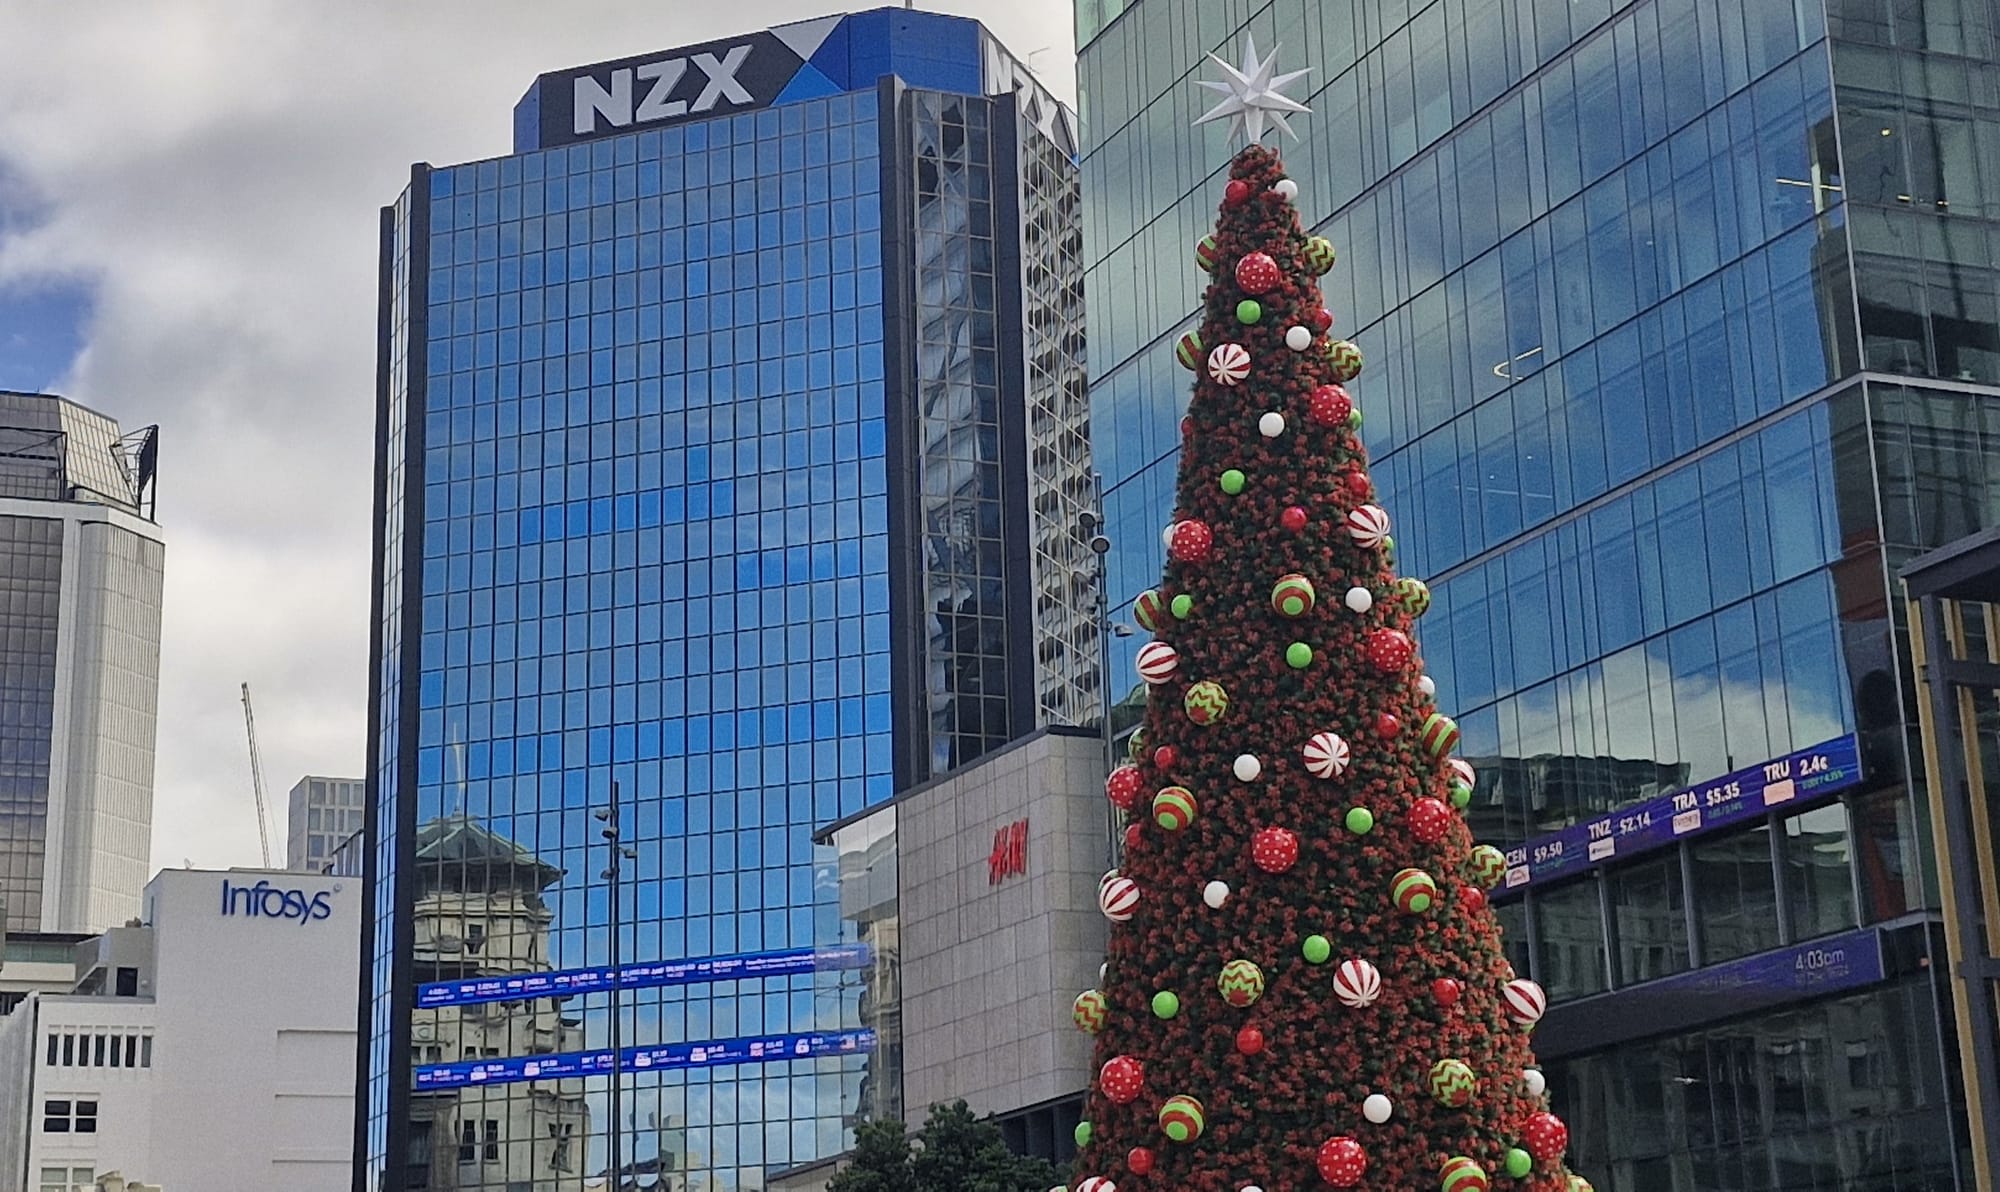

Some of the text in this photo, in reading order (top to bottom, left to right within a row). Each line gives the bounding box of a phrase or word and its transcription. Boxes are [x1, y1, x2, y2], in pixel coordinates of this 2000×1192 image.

[573, 43, 756, 136] NZX
[1506, 846, 1527, 867] CEN
[1588, 818, 1612, 840] TNZ
[1619, 811, 1651, 836] $2.14
[1672, 790, 1698, 811] TRA
[1706, 781, 1741, 807] $5.35
[1763, 759, 1790, 783] TRU
[221, 878, 332, 926] Infosys
